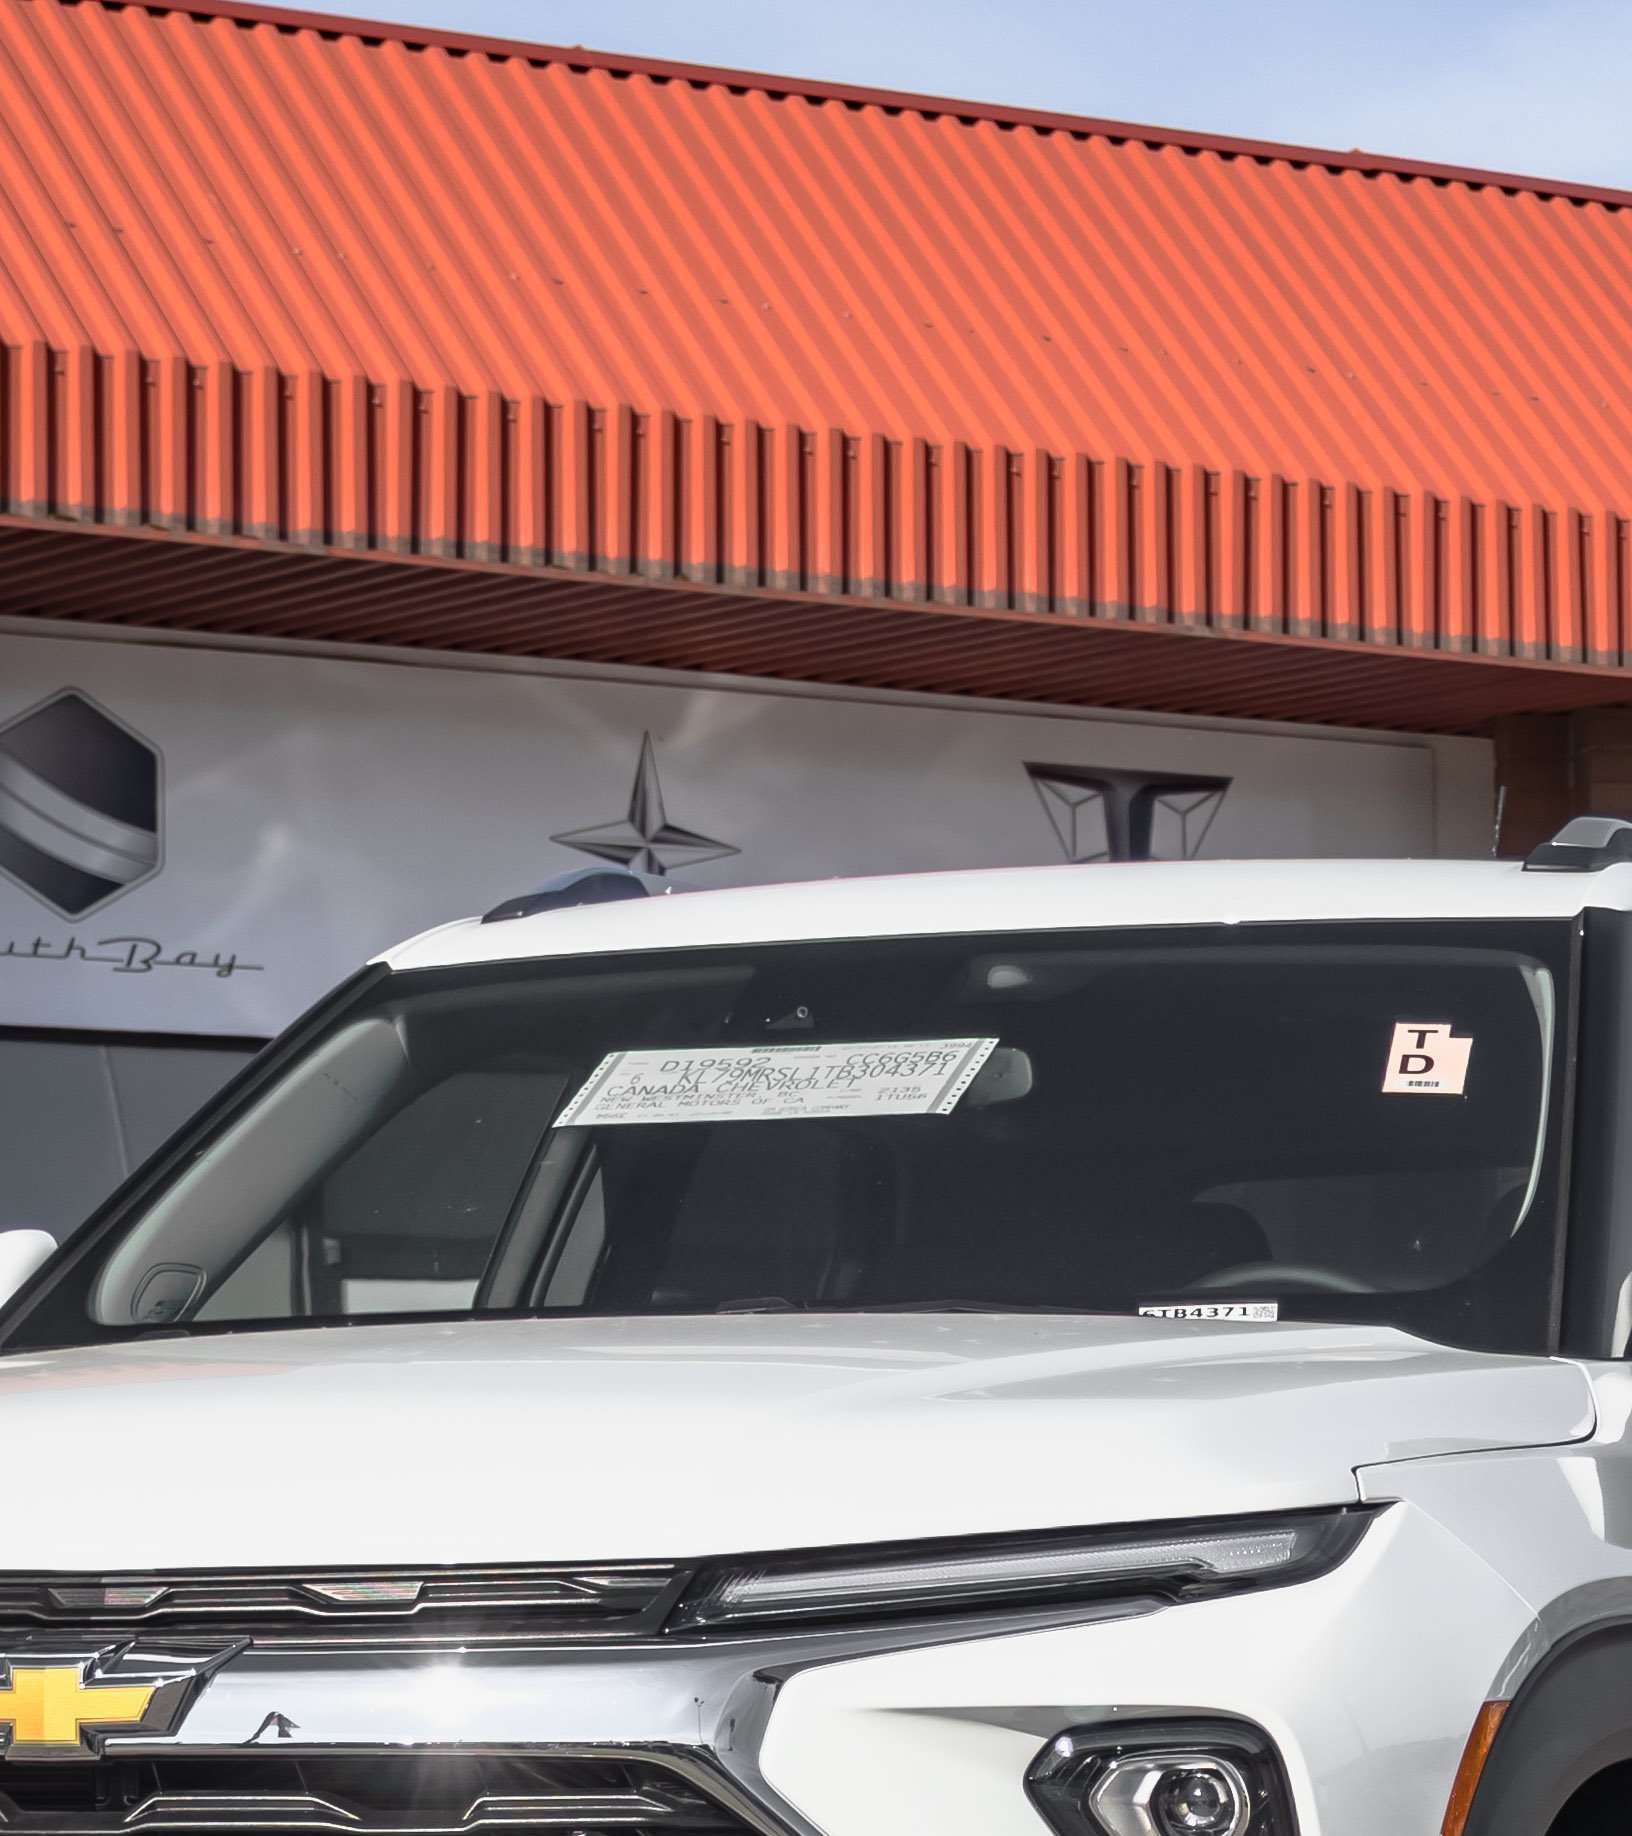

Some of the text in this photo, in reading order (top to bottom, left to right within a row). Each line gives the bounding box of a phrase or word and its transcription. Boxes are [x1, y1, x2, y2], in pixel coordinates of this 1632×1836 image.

[98, 938, 265, 977] Bay
[607, 1076, 856, 1098] CANADA CHEVROLET
